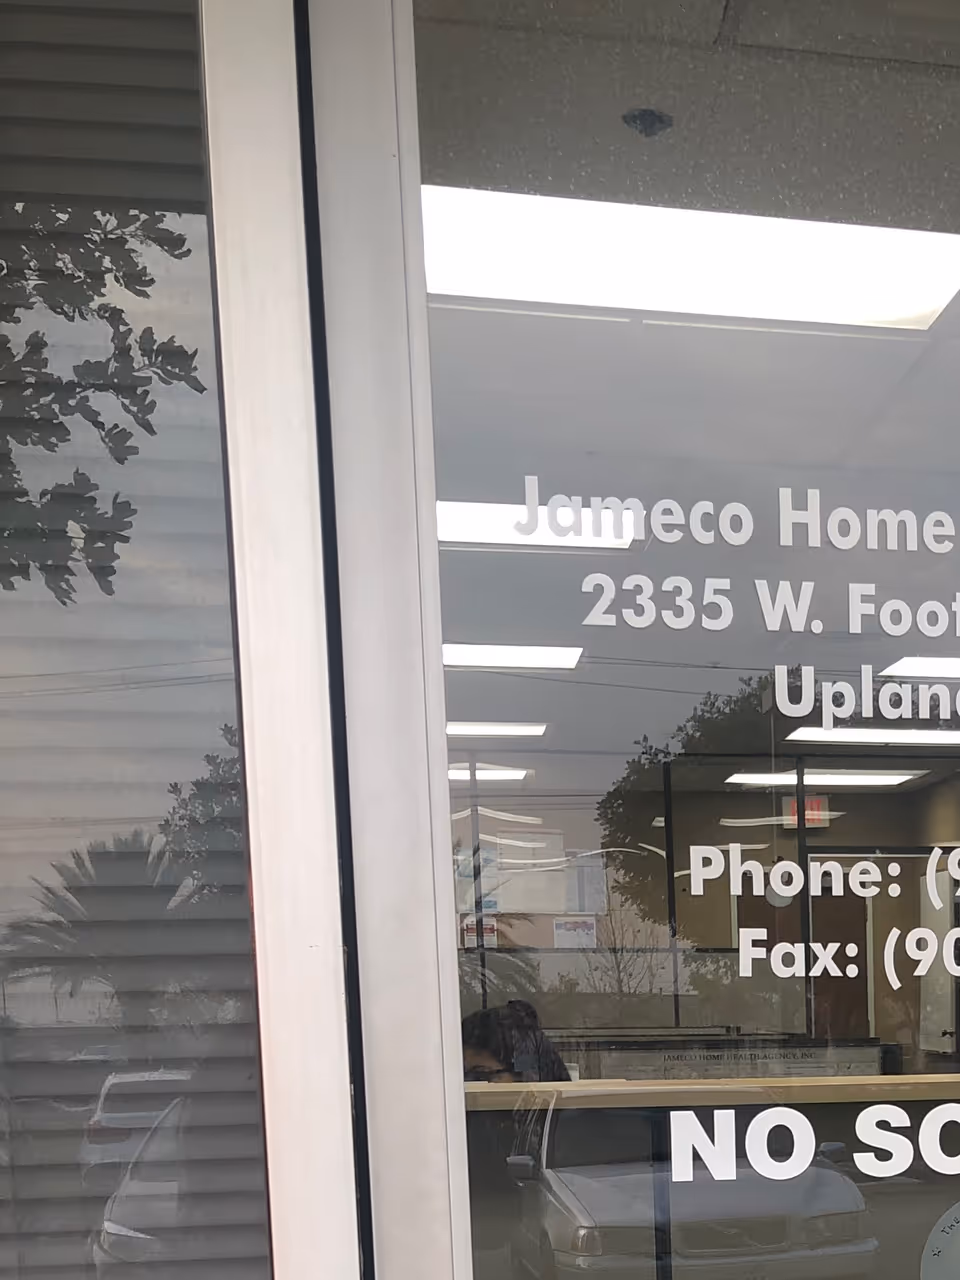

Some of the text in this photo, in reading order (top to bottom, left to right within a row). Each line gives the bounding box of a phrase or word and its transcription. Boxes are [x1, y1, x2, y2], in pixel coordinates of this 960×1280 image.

[514, 476, 754, 546] Jameco
[778, 487, 954, 554] Home
[580, 573, 733, 630] 2335
[754, 579, 823, 633] W.
[689, 843, 901, 897] Phone:
[738, 927, 858, 978] Fax:
[670, 1107, 816, 1182] NO
